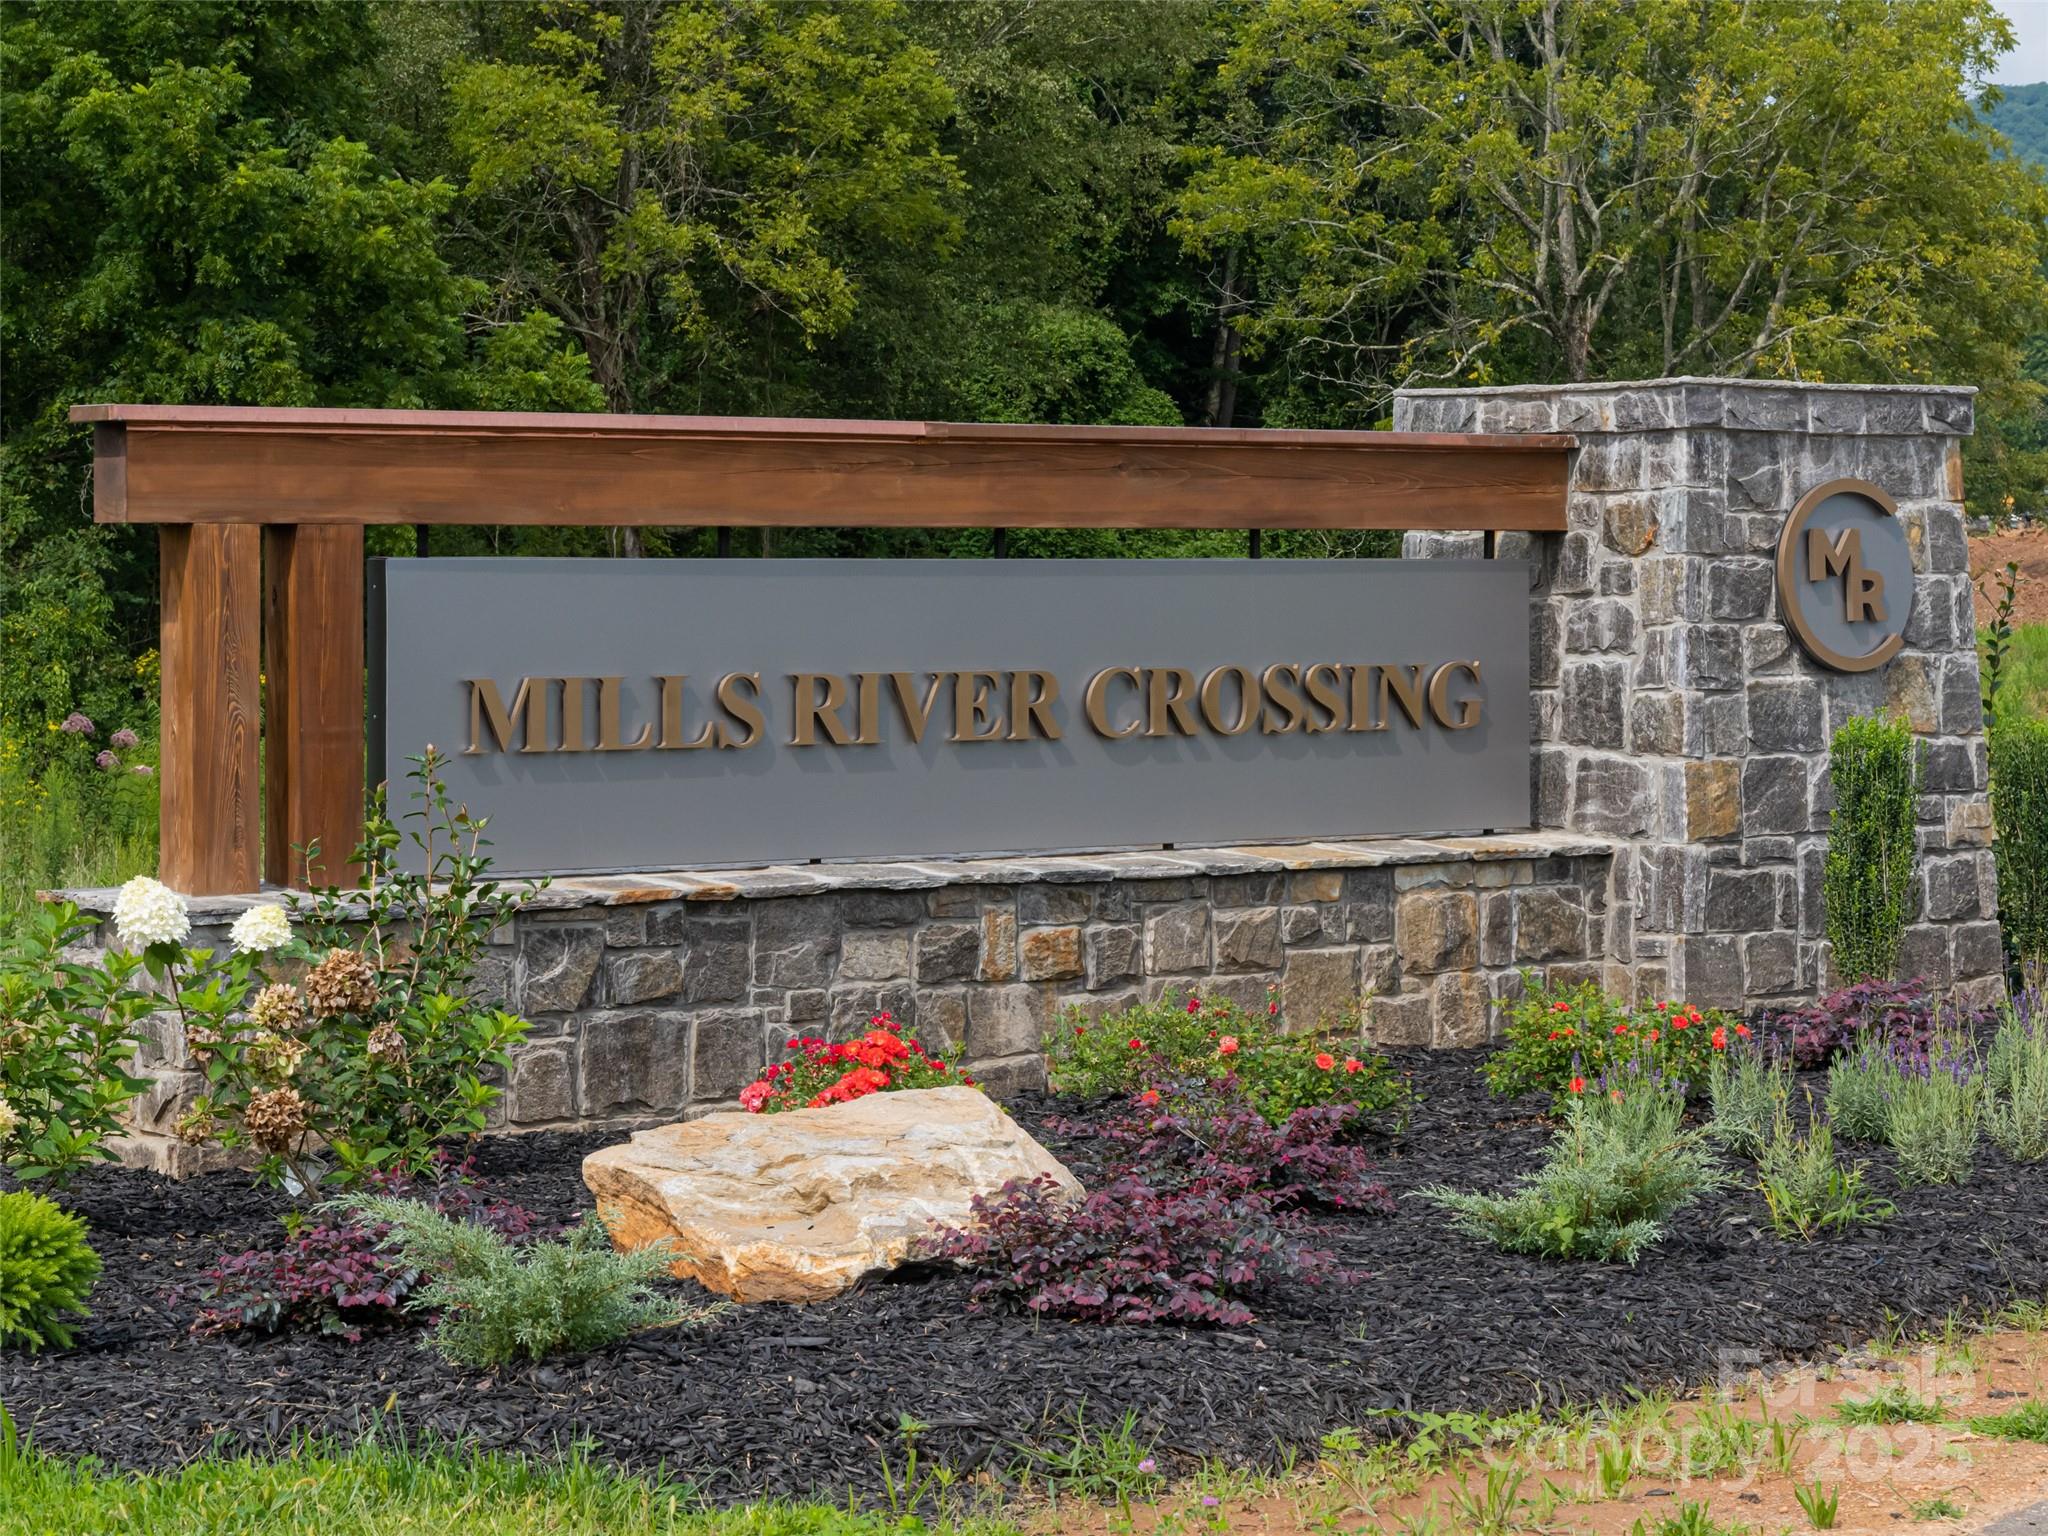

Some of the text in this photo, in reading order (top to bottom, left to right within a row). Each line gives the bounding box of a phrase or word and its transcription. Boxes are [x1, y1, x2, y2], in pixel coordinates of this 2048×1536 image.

[463, 660, 1484, 756] MILLS RIVER CROSSING
